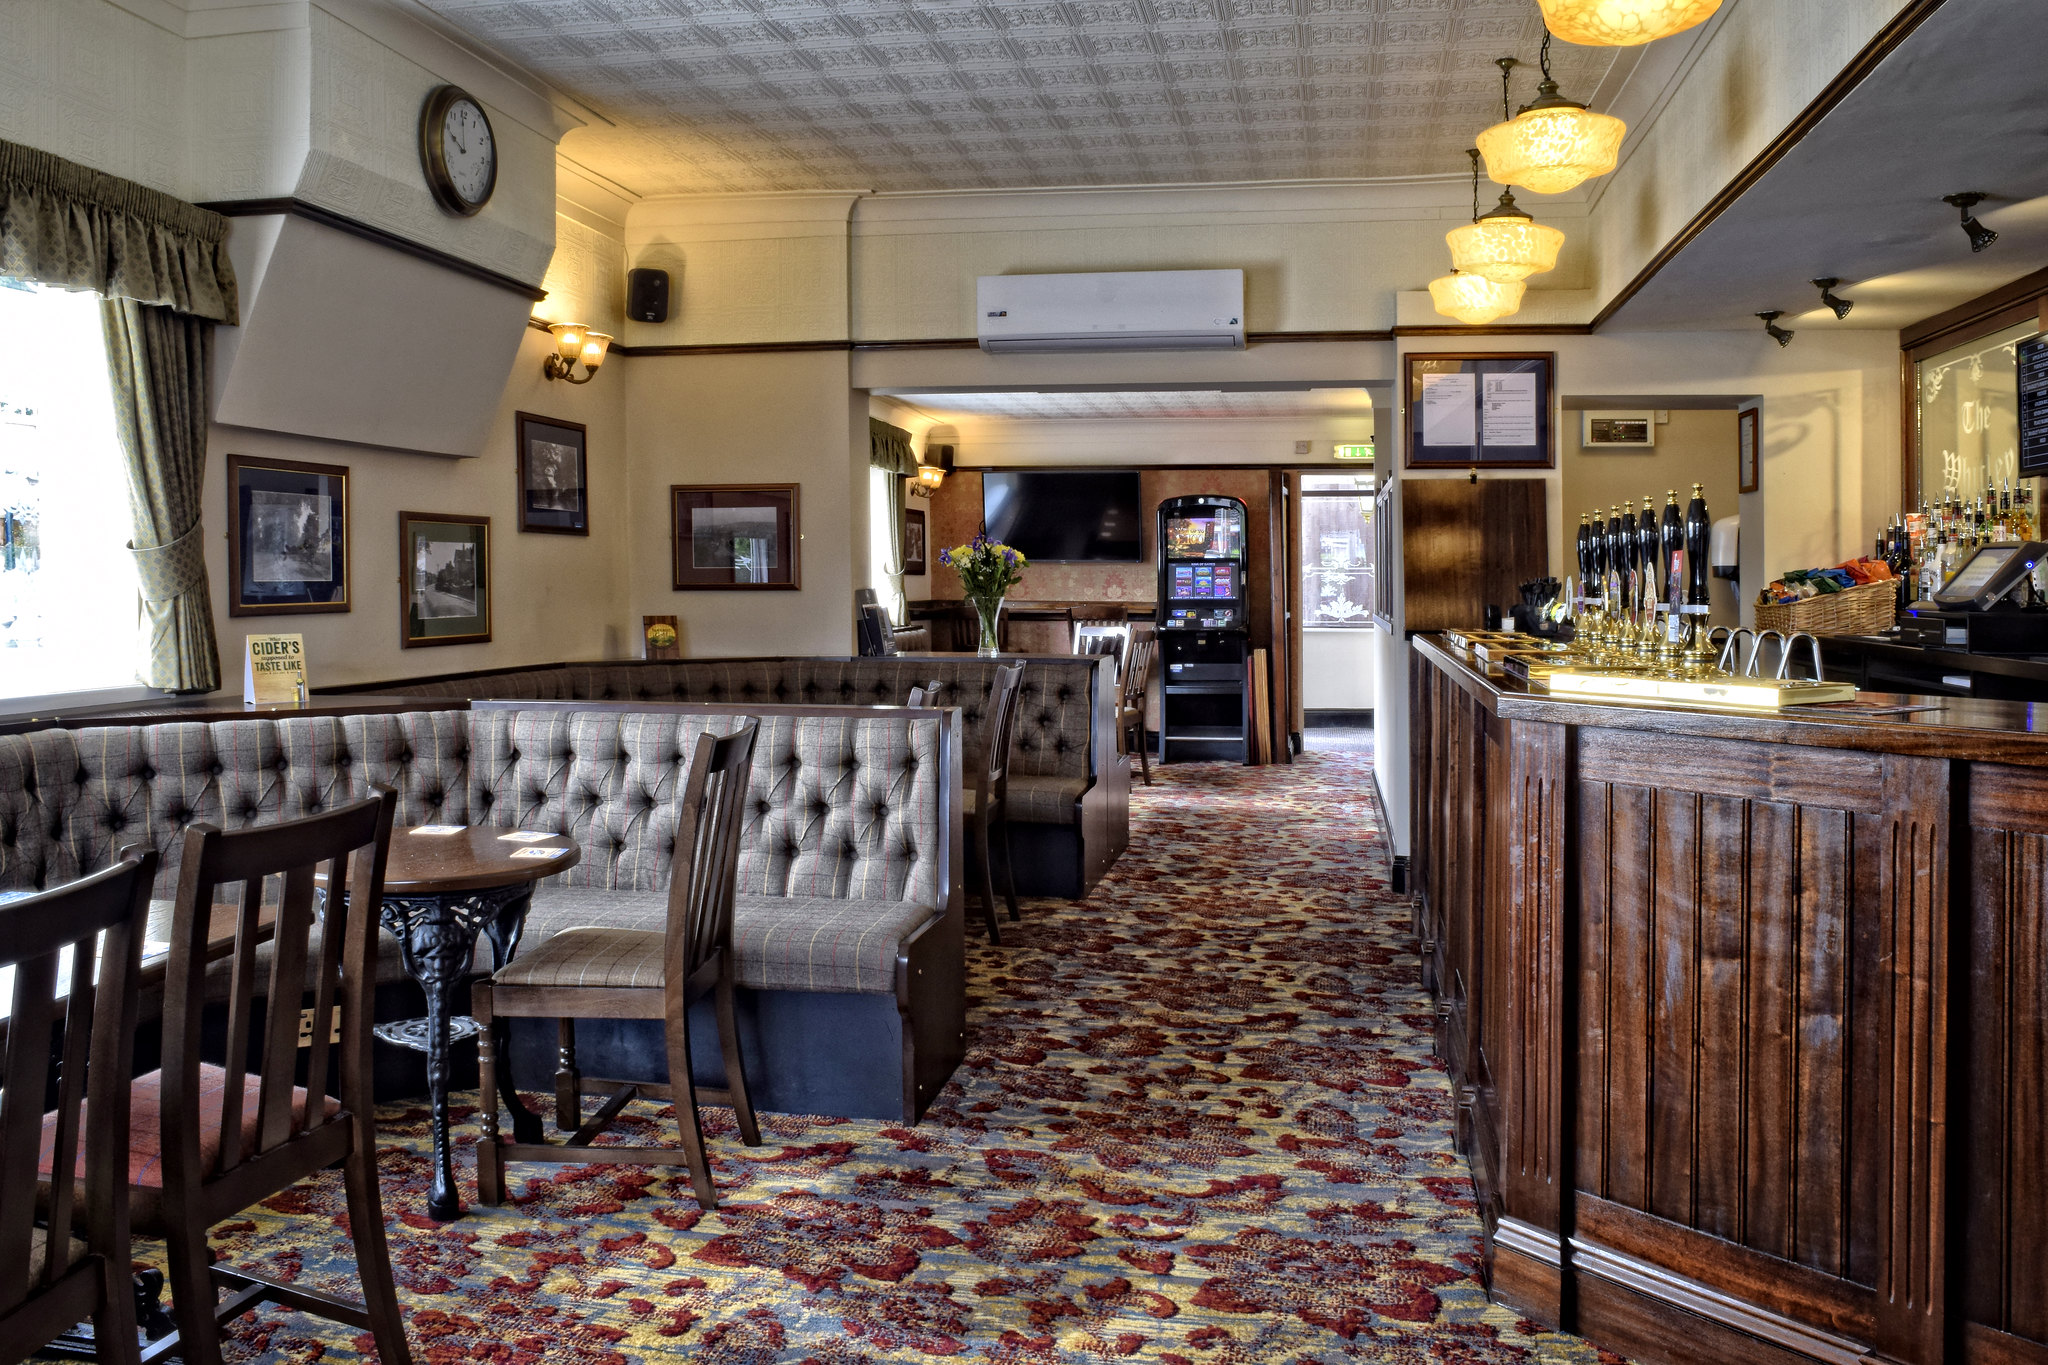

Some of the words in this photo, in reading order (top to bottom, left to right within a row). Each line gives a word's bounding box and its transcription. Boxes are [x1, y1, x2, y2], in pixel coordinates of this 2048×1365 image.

[1961, 399, 1992, 434] The
[252, 641, 300, 655] CIDER'S
[255, 661, 282, 672] TASTE
[283, 660, 302, 670] LIKE
